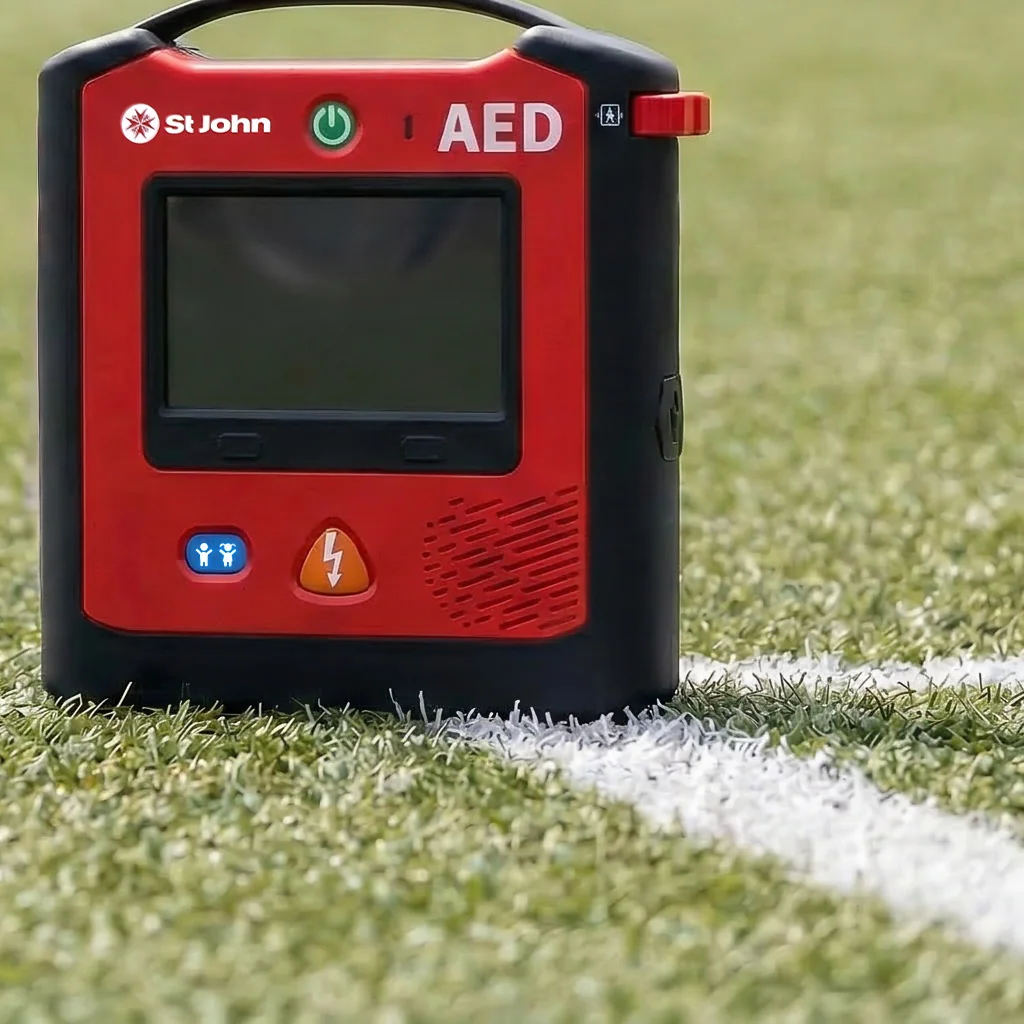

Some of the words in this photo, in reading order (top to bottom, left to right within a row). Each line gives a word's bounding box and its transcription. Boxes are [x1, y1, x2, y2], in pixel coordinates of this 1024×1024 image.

[164, 114, 194, 134] St
[199, 114, 271, 134] John
[437, 102, 563, 153] AED
